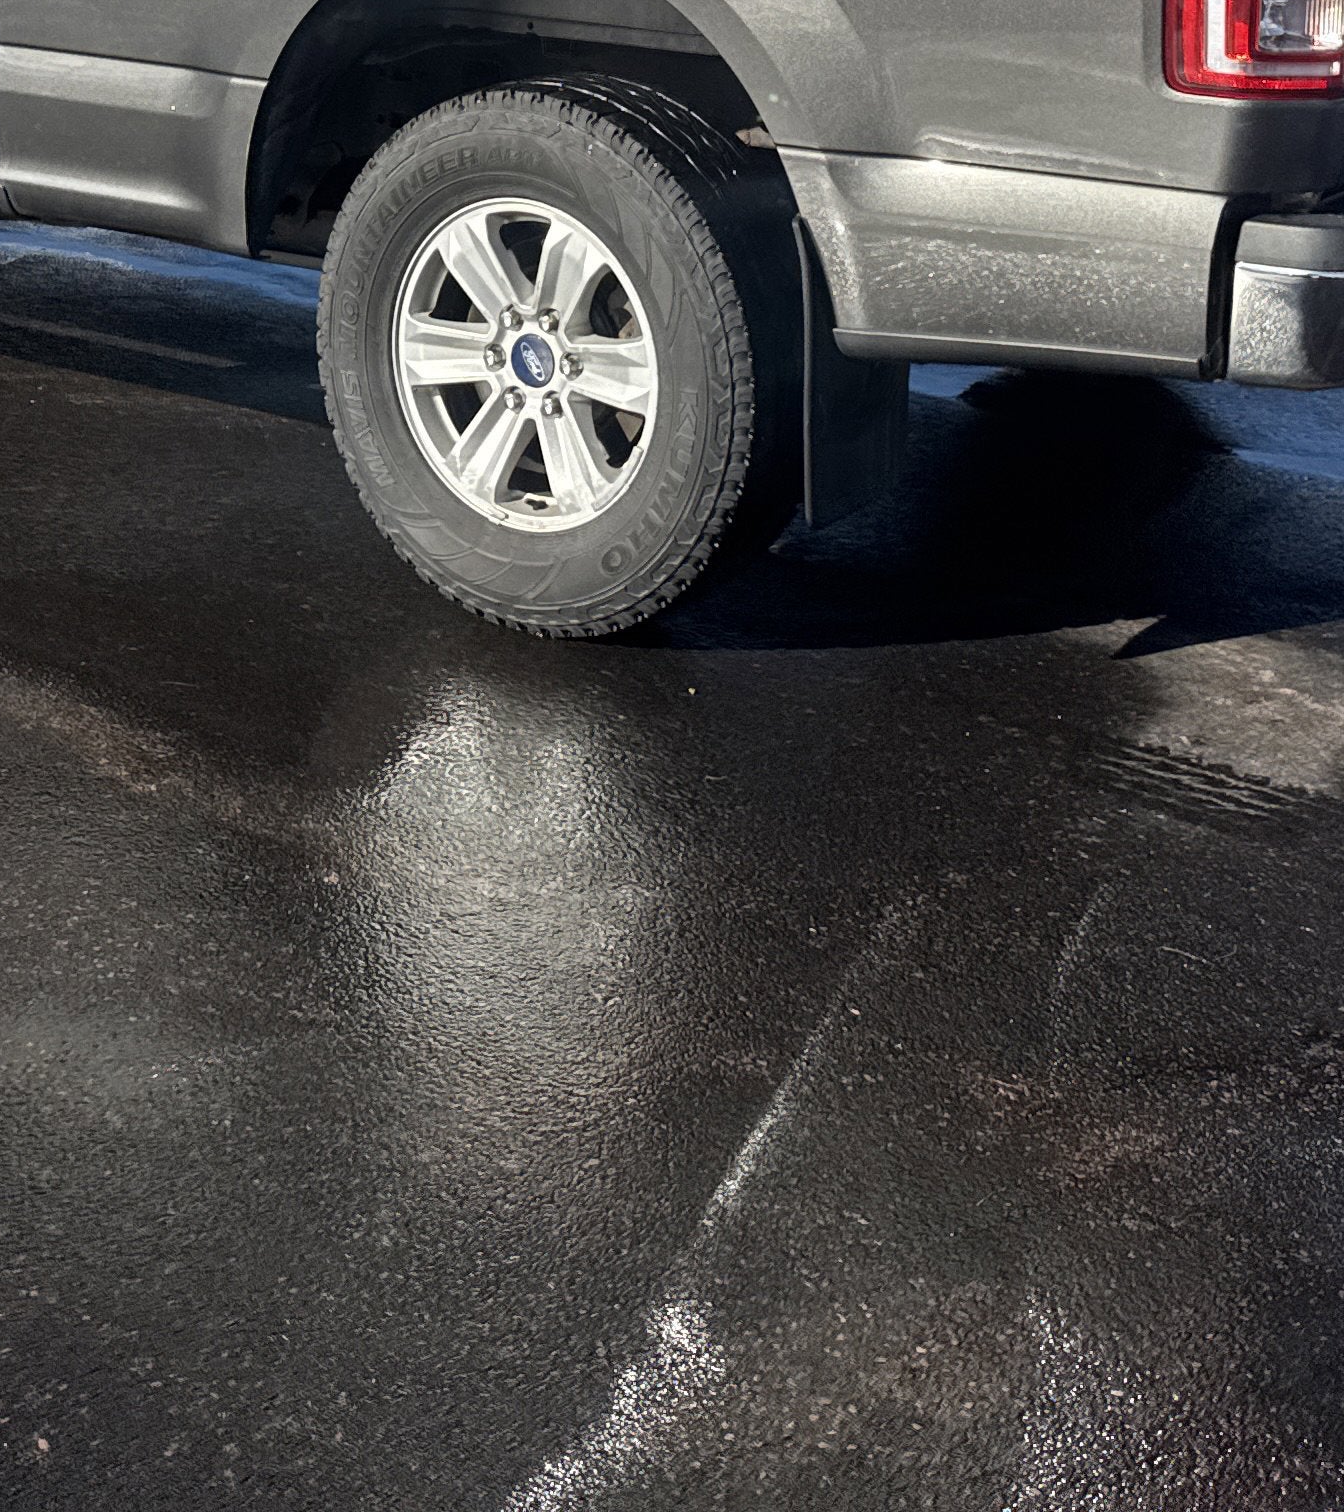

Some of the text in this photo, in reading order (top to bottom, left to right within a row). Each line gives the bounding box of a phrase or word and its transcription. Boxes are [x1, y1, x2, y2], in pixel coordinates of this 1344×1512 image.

[338, 144, 481, 351] MOUNTAINEER
[340, 369, 396, 488] MAVIS
[599, 390, 700, 578] KUMHO
